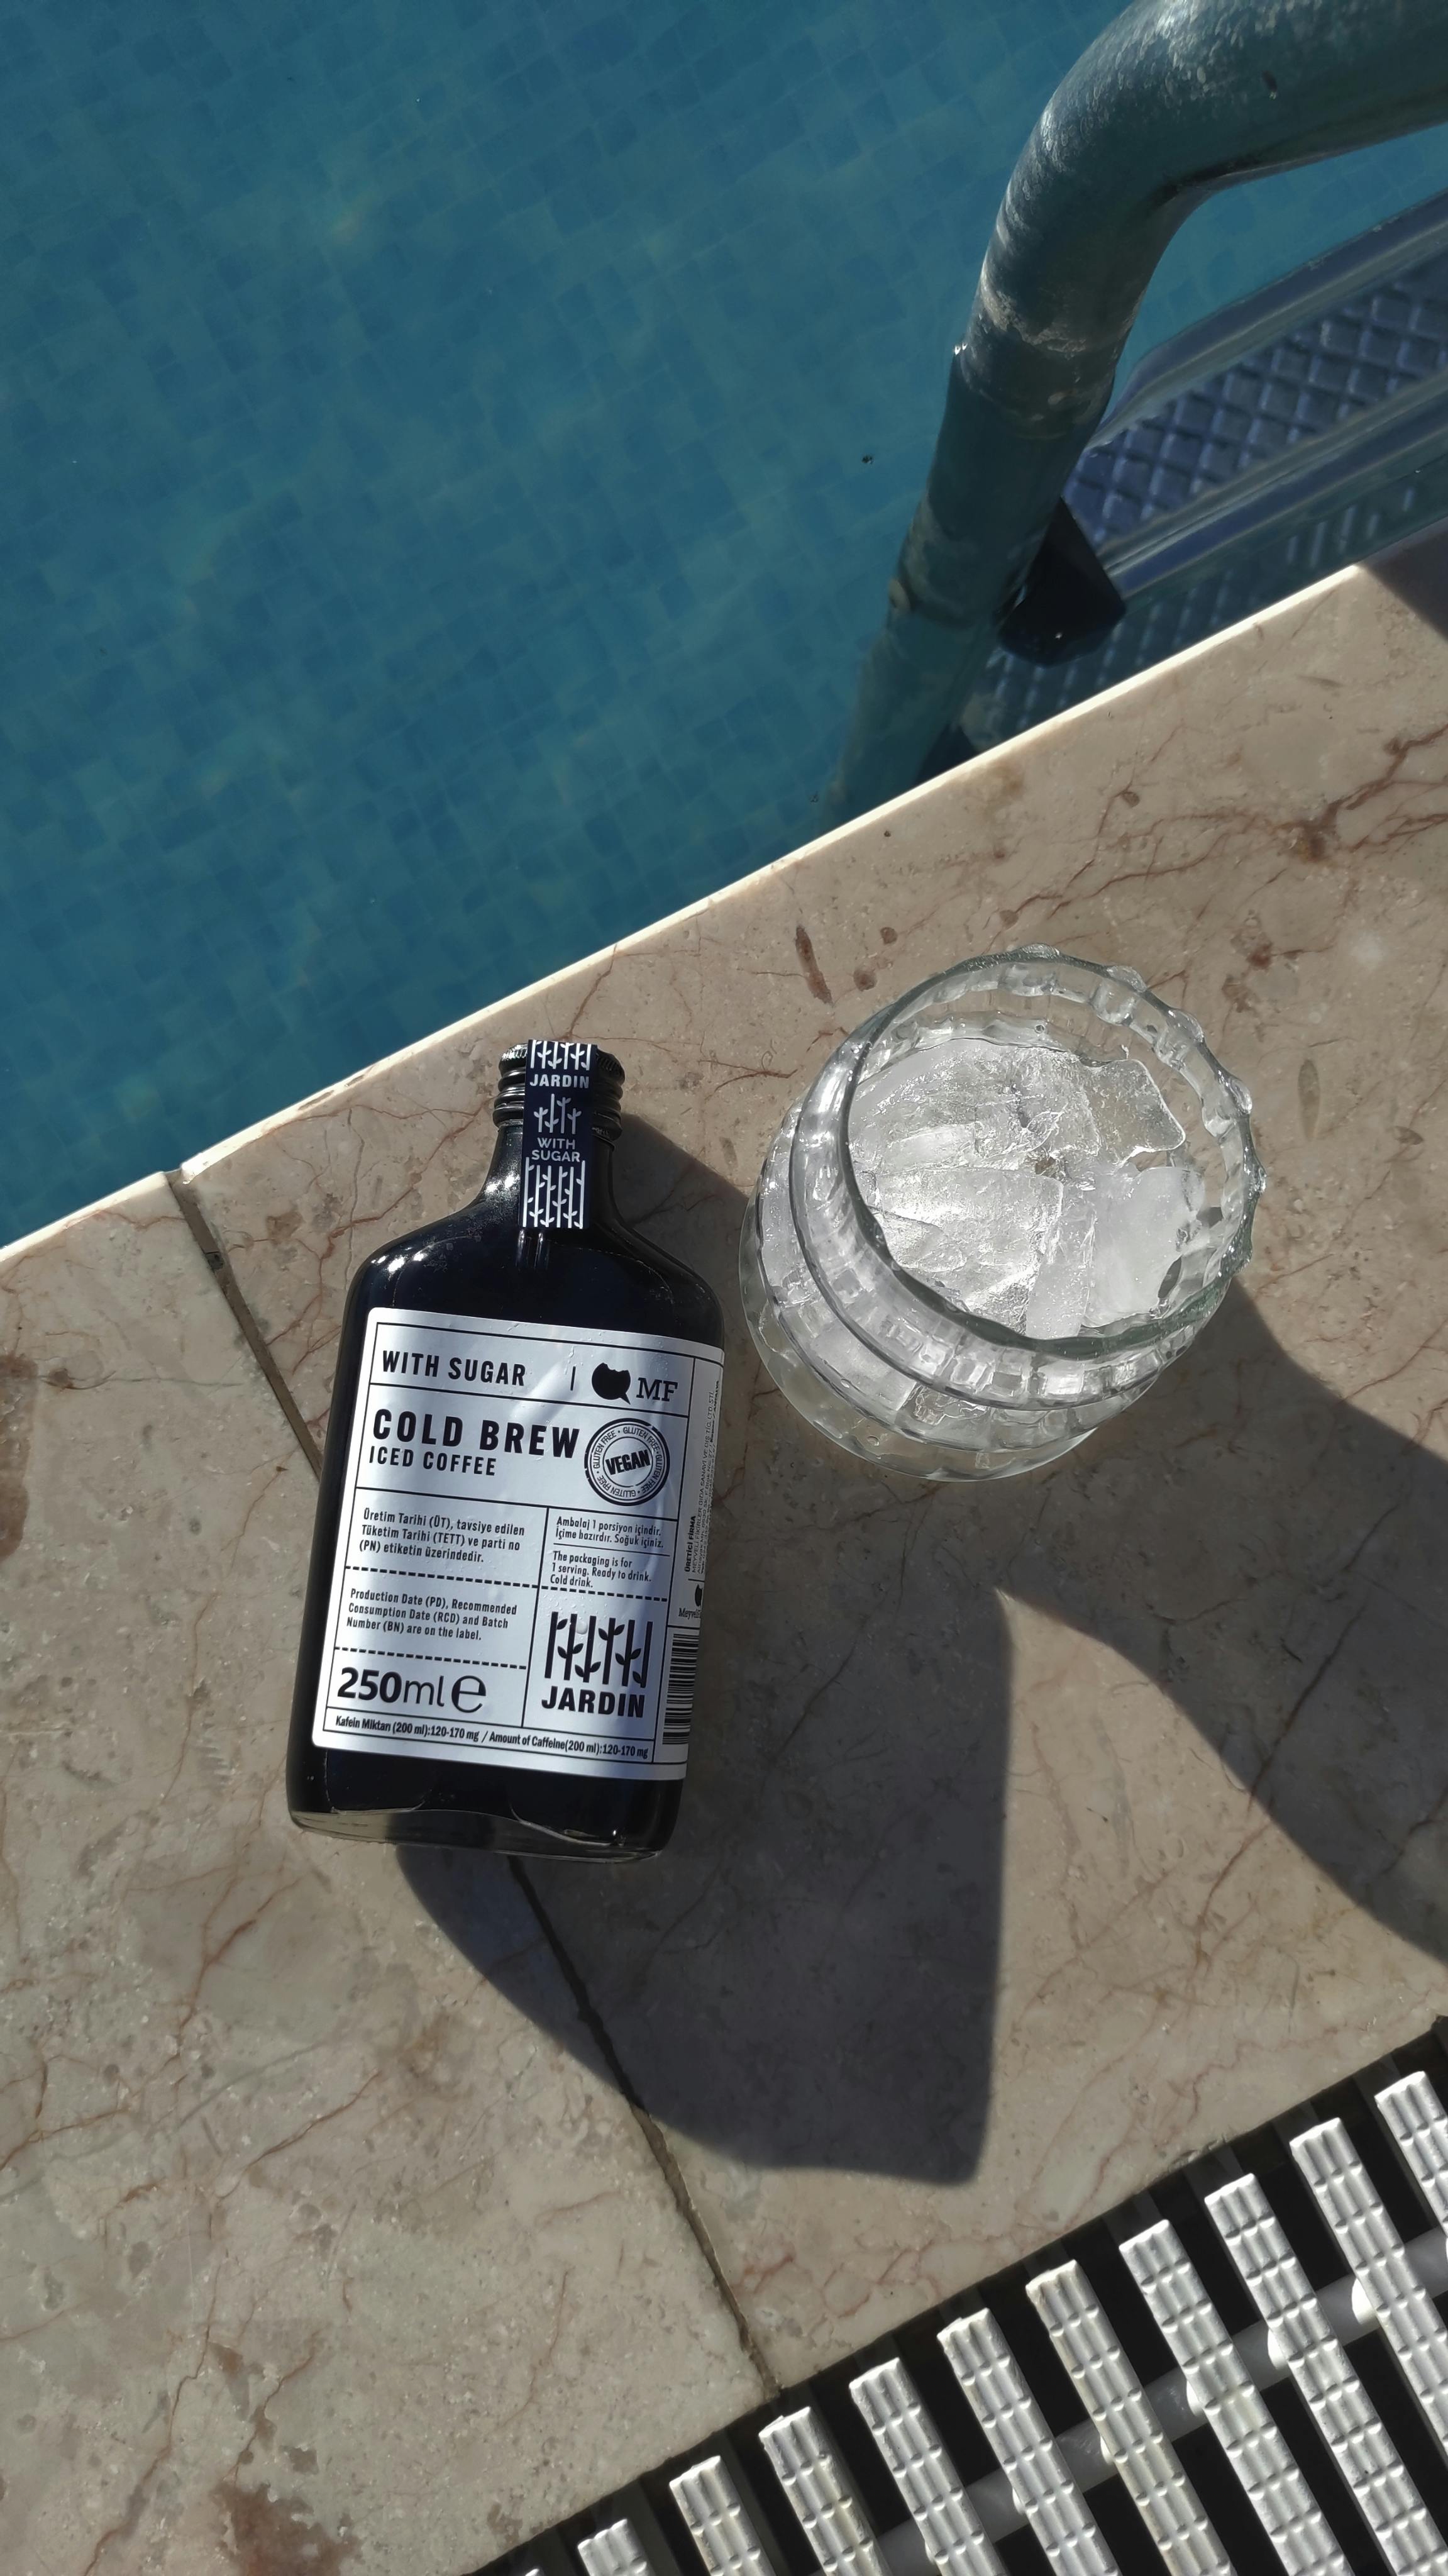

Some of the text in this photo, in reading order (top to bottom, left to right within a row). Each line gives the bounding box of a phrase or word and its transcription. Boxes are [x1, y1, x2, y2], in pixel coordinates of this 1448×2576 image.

[530, 1074, 589, 1089] JARDIN
[531, 1150, 580, 1162] SUGAR
[537, 1137, 575, 1150] WITH
[383, 1350, 526, 1386] WITH SUGAR
[636, 1377, 678, 1402] MF
[373, 1408, 580, 1458] COLD BREW
[622, 1426, 660, 1452] GLUTEN FREE
[369, 1445, 496, 1476] ICED COFFEE
[593, 1430, 617, 1469] GLUTEN FREE
[605, 1449, 651, 1475] VEGAN
[597, 1475, 636, 1497] GLUTEN FREE
[641, 1479, 657, 1494] FREE
[364, 1507, 395, 1523] Üretim
[399, 1513, 426, 1526] Tarihi
[456, 1519, 492, 1534] tavsiye
[495, 1523, 524, 1536] edilen
[556, 1516, 590, 1531] Ambalaj
[593, 1519, 596, 1529] 1
[599, 1521, 633, 1533] porsiyon
[362, 1524, 520, 1551] Tüketim Tarihi (TETT) ve parti no
[614, 1534, 639, 1546] Soğuk
[641, 1536, 664, 1548] içiniz.
[359, 1540, 484, 1562] (PN) etiketin üzerindedir.
[553, 1550, 633, 1568] The packaging is for
[550, 1574, 594, 1588] Cold drink.
[552, 1563, 651, 1582] 1 serving. Ready to drink.
[350, 1588, 517, 1615] Production Date (PD), Recommended
[348, 1602, 509, 1629] Consumption Date (RCD) and Batch
[346, 1616, 482, 1641] Number (BN) are on the label.
[337, 1667, 445, 1707] 250ml
[541, 1685, 645, 1718] JARDIN
[336, 1715, 360, 1728] Kafein
[392, 1721, 413, 1735] (200
[466, 1731, 480, 1742] mg
[481, 1730, 489, 1743] /
[489, 1731, 521, 1745] Amount
[522, 1735, 531, 1745] of
[637, 1748, 649, 1760] mg
